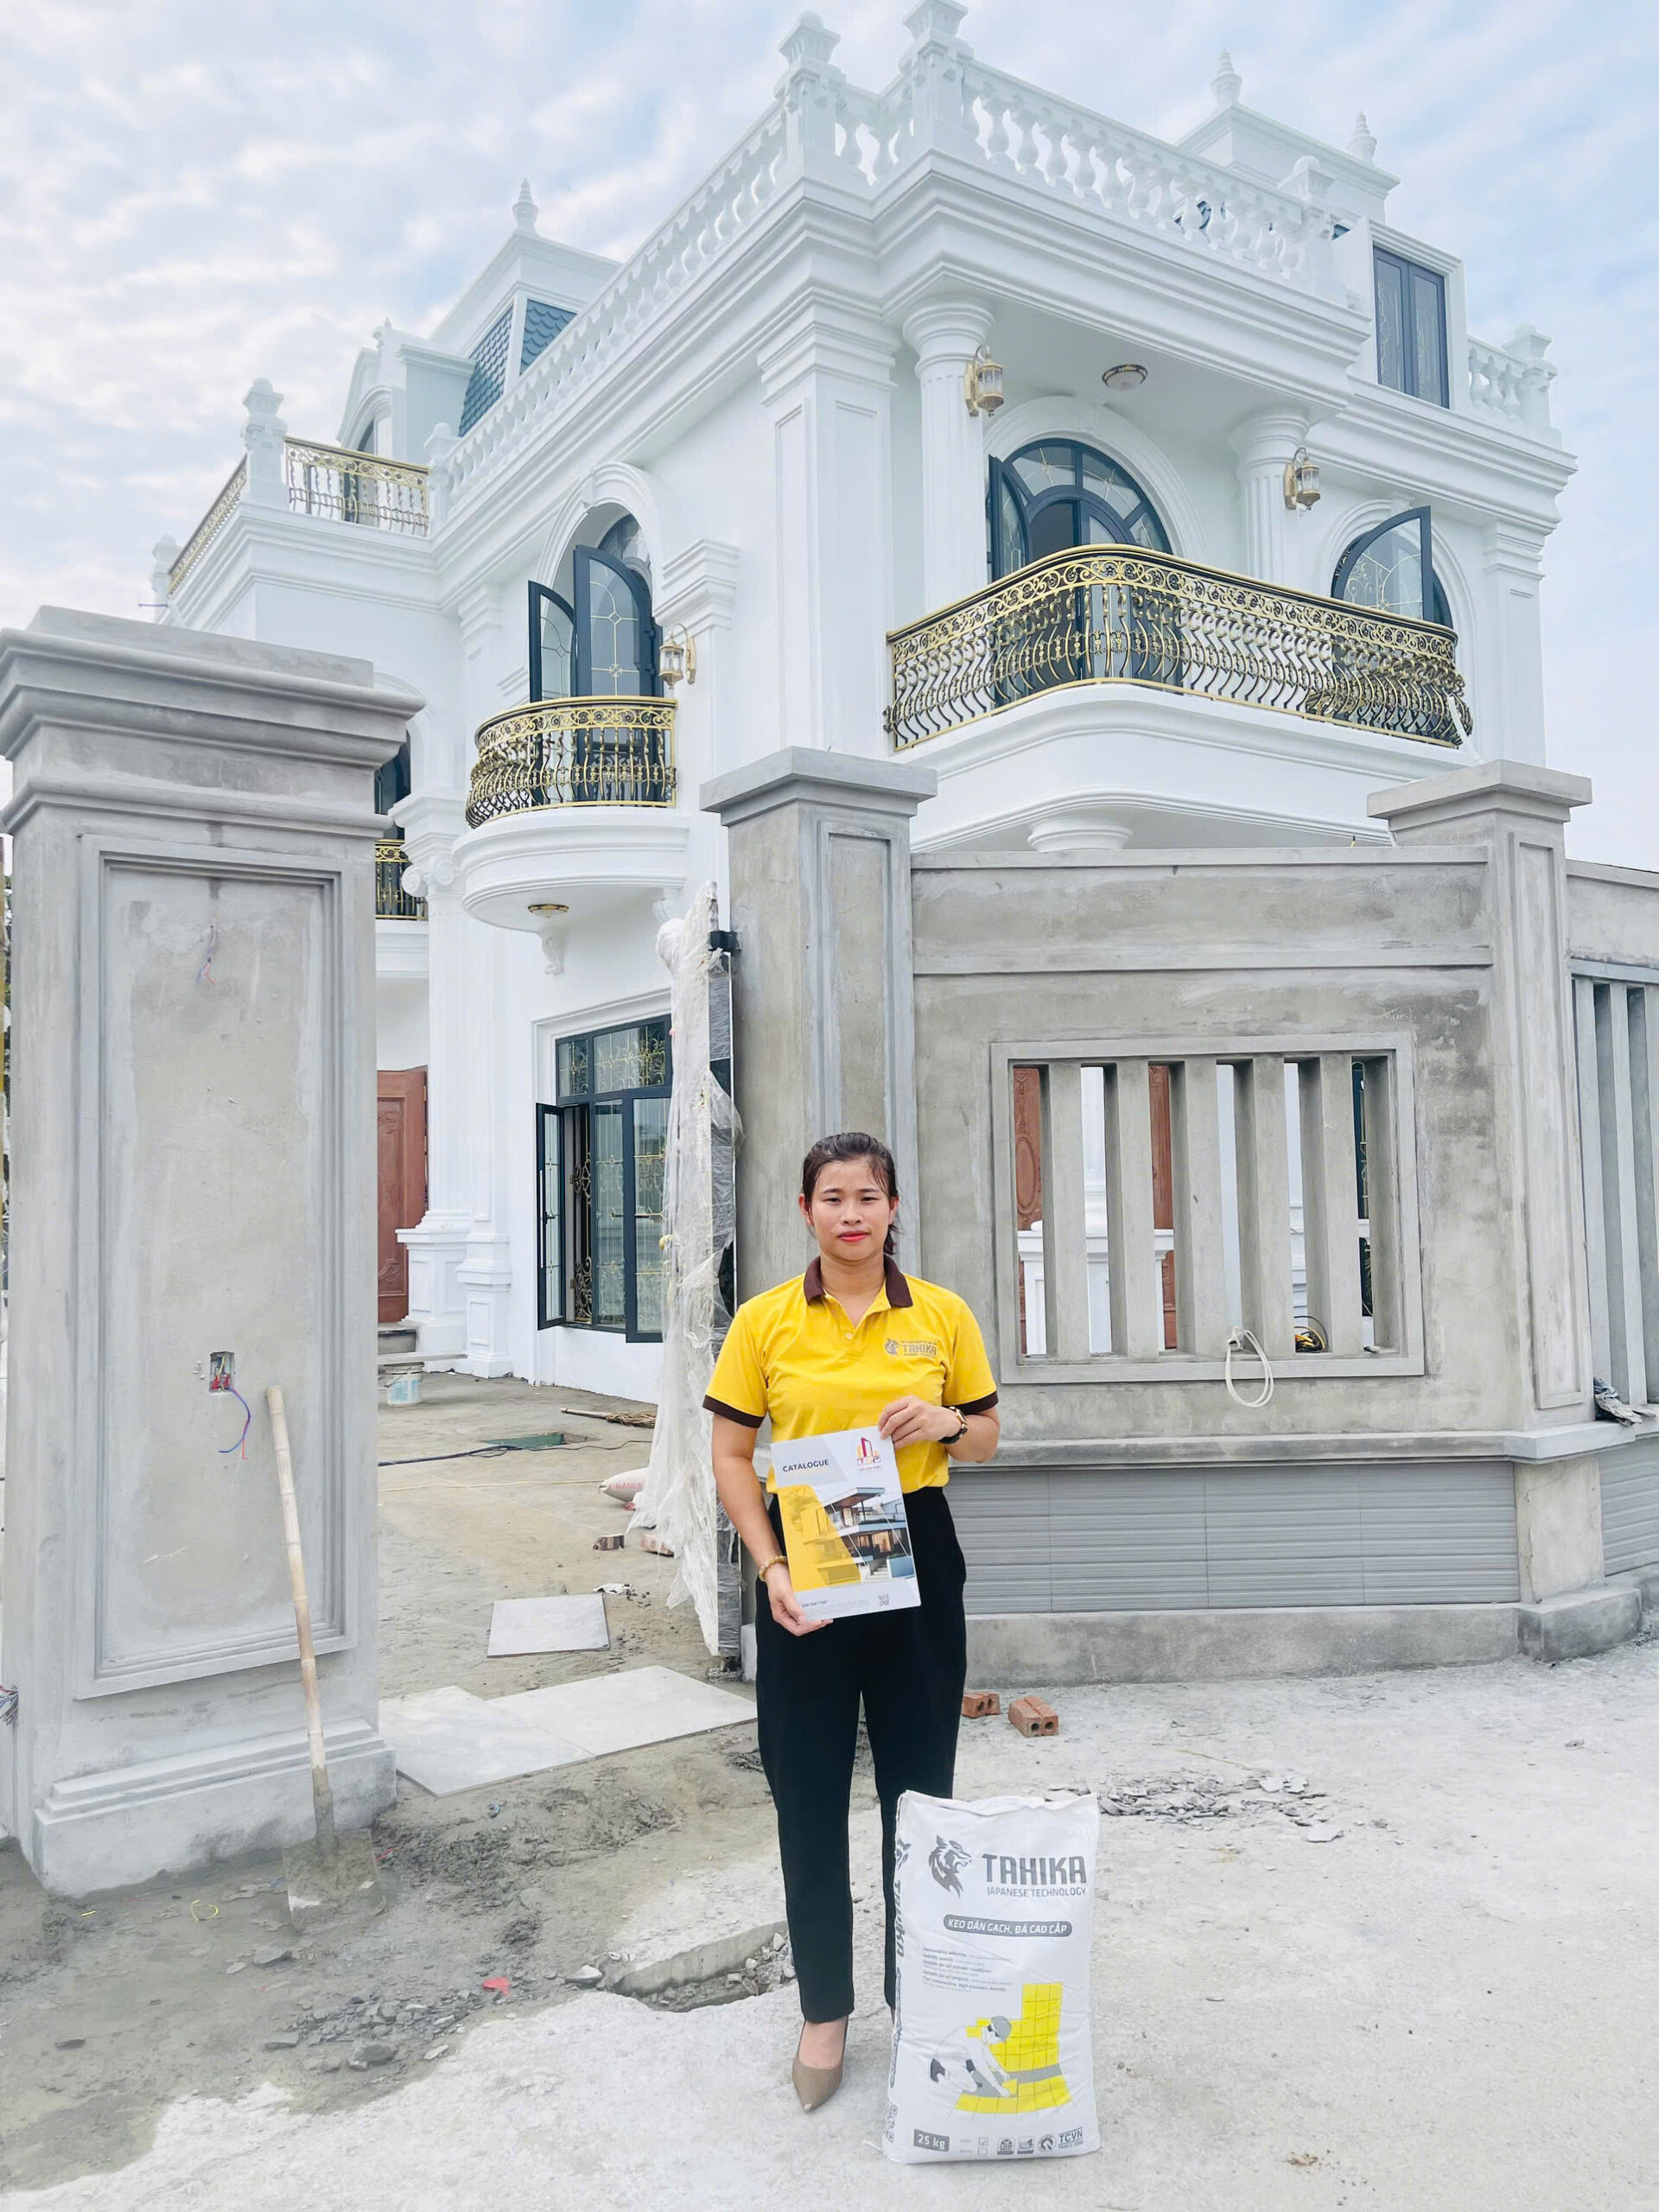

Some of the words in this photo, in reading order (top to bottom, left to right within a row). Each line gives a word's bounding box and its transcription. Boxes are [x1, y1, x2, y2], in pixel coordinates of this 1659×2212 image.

[903, 1344, 937, 1357] TAHIKA
[782, 1459, 830, 1472] CATALOGUE
[982, 1853, 1087, 1885] TAHIKA
[987, 1886, 1028, 1897] JAPANESE
[1030, 1886, 1086, 1897] TECHNOLOGY
[948, 1917, 966, 1929] KEO
[1029, 1924, 1047, 1934] CAO
[918, 2133, 931, 2145] 25
[933, 2137, 946, 2151] kg
[1058, 2128, 1083, 2143] TCVN
